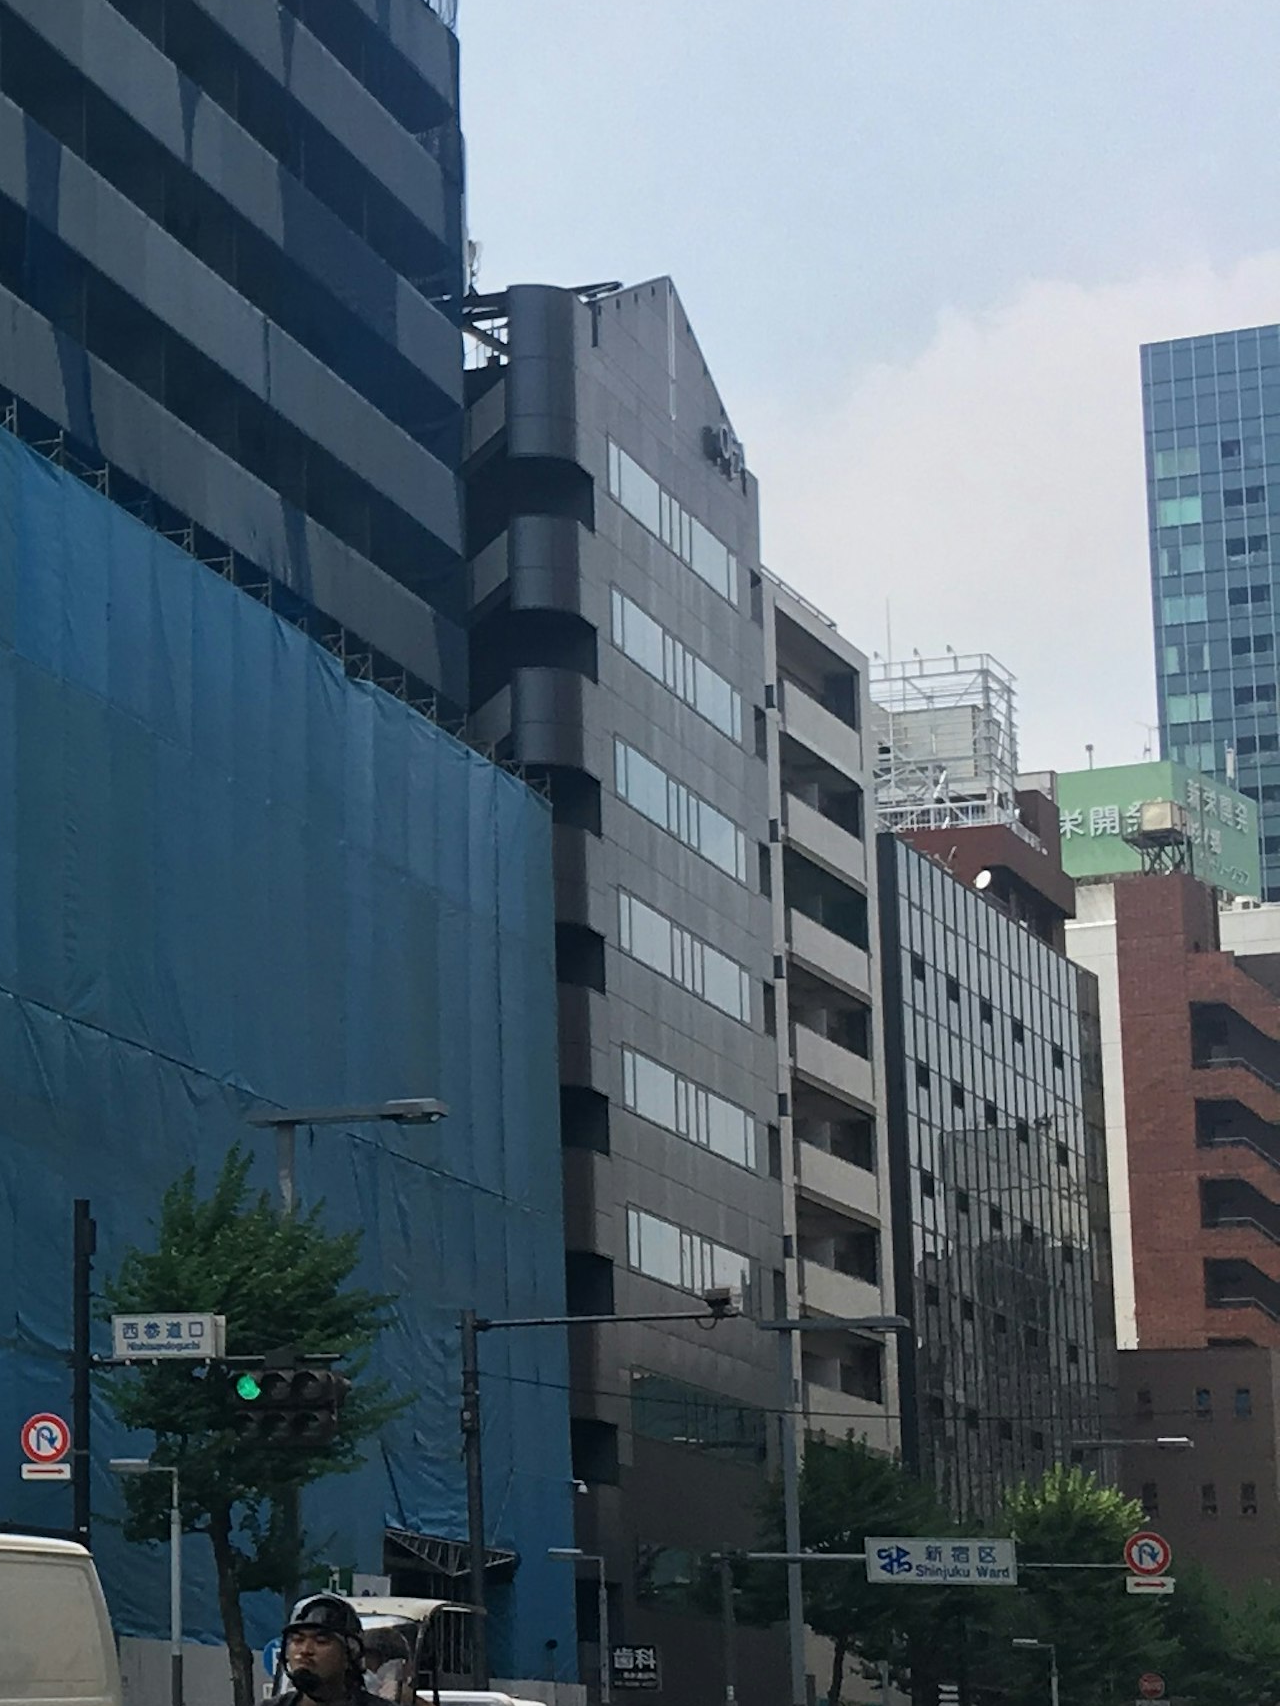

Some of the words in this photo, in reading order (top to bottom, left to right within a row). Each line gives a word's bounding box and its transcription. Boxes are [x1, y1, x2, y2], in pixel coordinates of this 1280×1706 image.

[121, 1320, 204, 1339] 西参道口
[925, 1544, 997, 1564] 新宿区
[915, 1564, 971, 1581] Shinjuku
[976, 1565, 1010, 1579] Ward
[613, 1647, 657, 1669] 歯科
